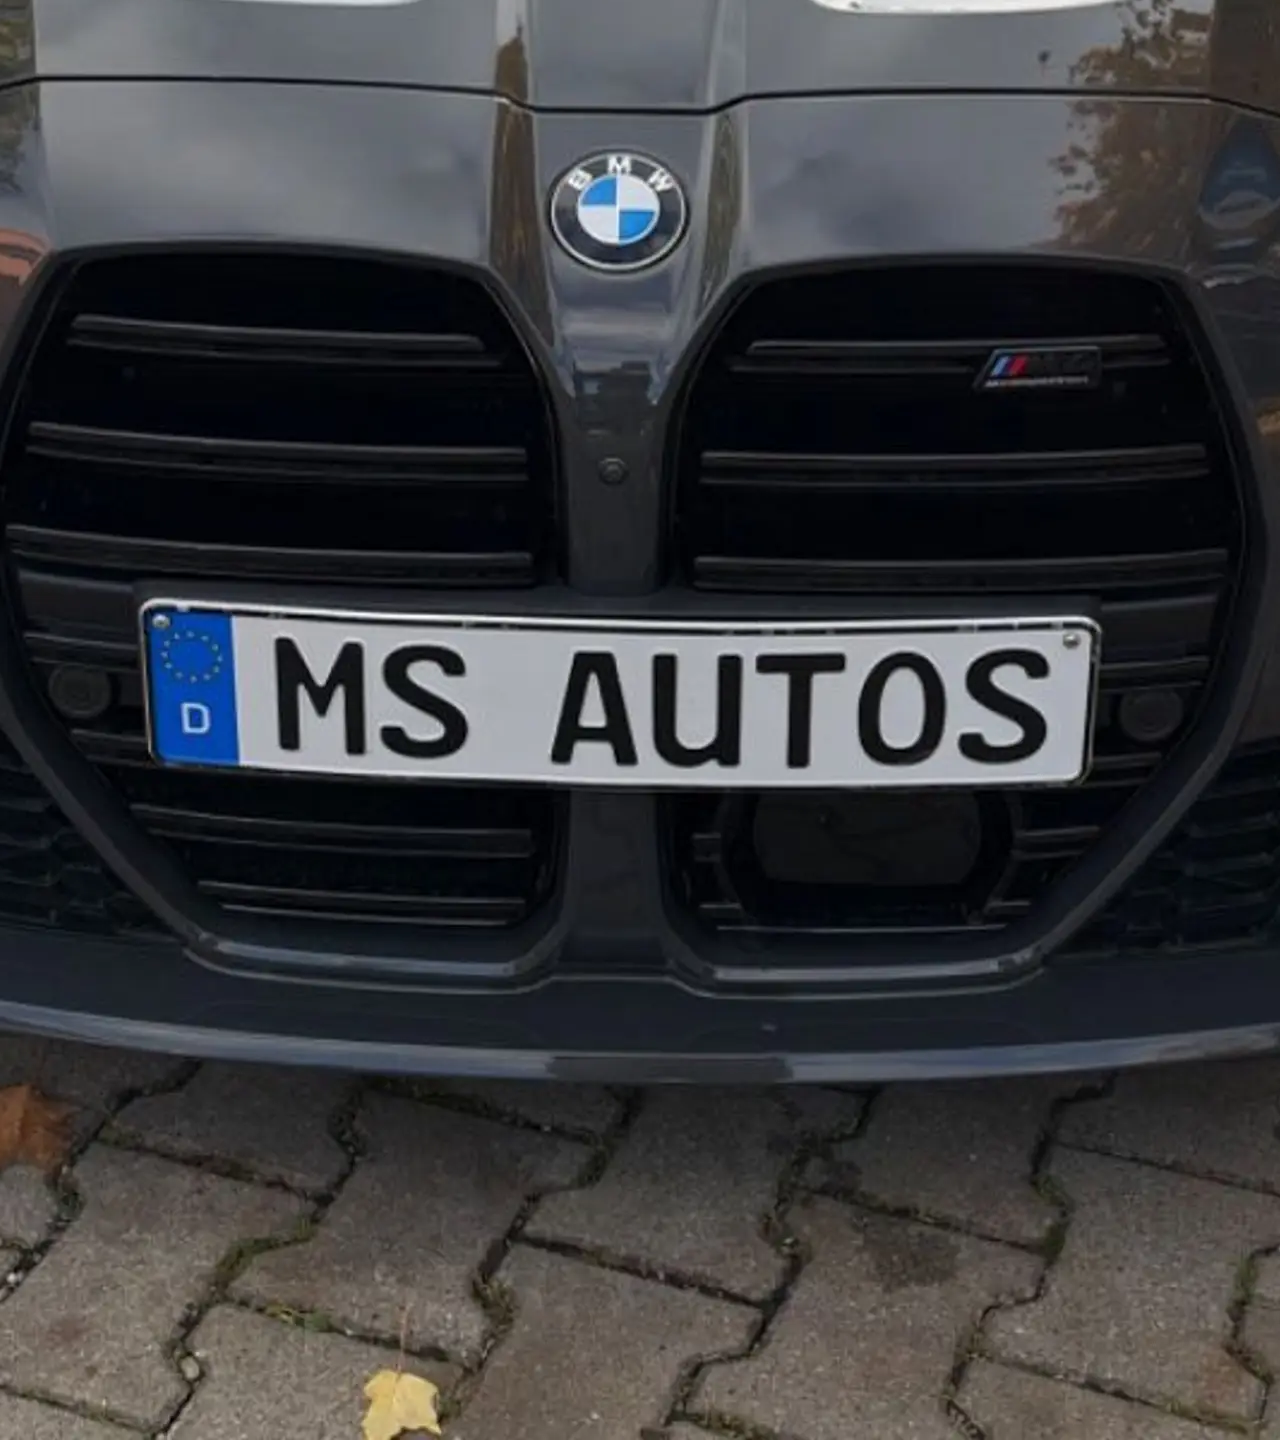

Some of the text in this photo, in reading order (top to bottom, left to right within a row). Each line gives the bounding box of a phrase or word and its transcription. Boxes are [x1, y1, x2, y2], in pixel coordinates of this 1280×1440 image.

[567, 154, 676, 192] BMW
[181, 702, 211, 734] D
[274, 637, 1050, 769] MS AUTOS
